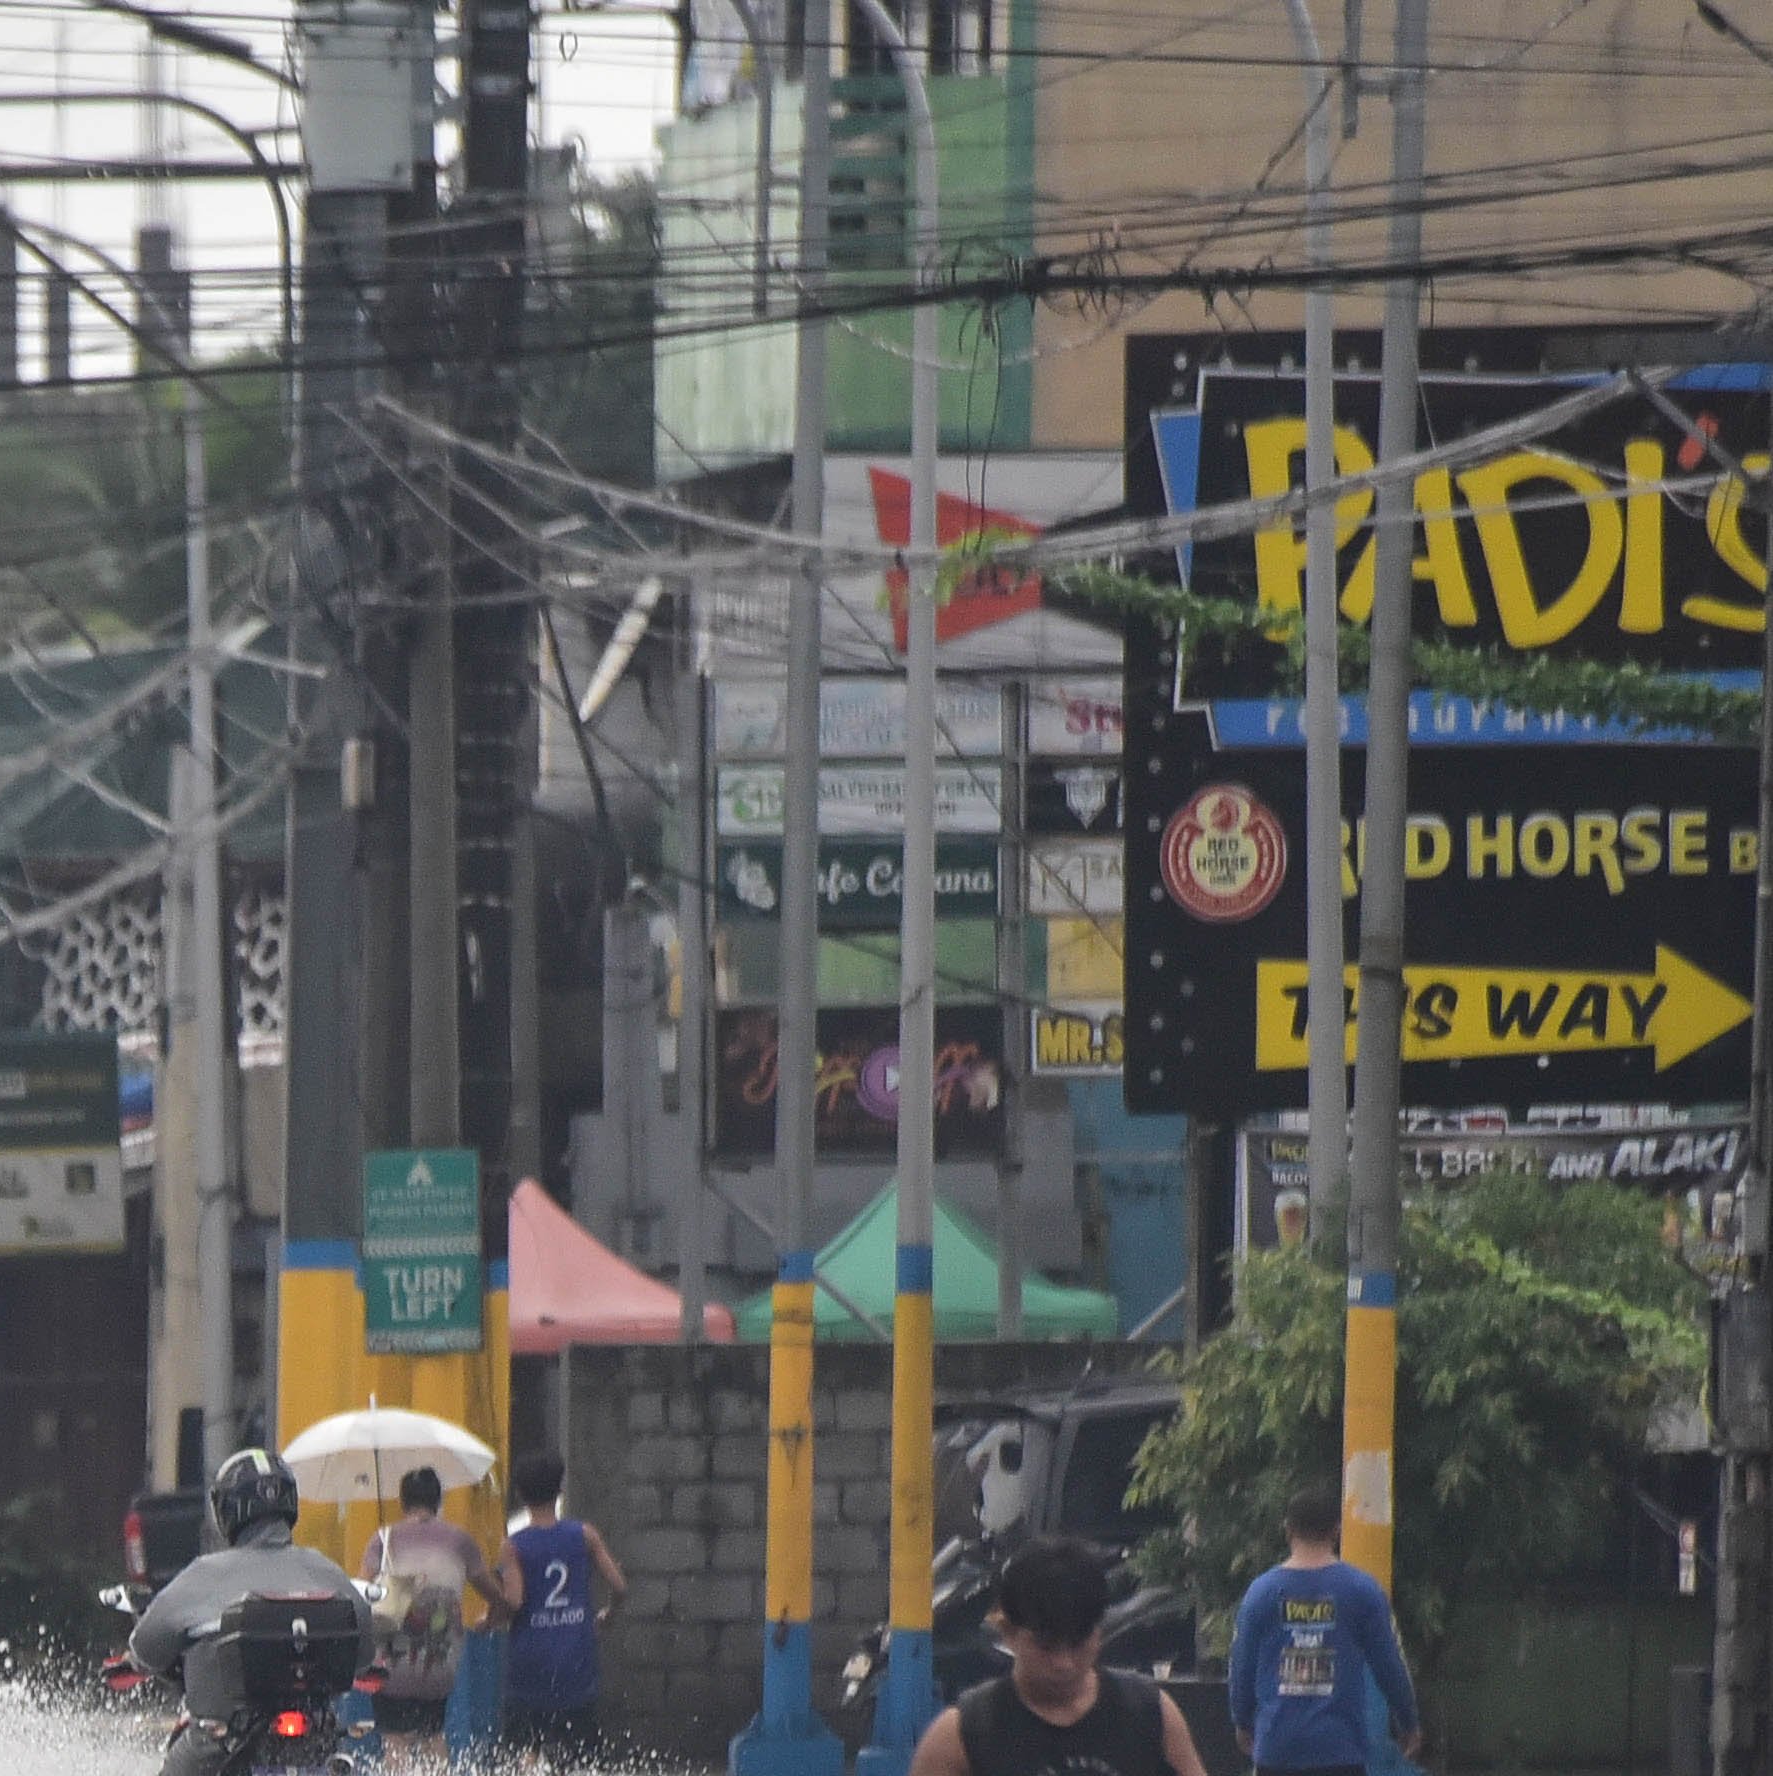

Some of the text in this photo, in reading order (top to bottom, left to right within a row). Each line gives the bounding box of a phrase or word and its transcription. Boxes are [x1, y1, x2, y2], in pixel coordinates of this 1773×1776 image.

[1466, 809, 1709, 896] HORSE
[1485, 982, 1668, 1041] WAY
[384, 1267, 464, 1293] TURN
[390, 1296, 454, 1321] LEFT
[544, 1560, 570, 1609] 2
